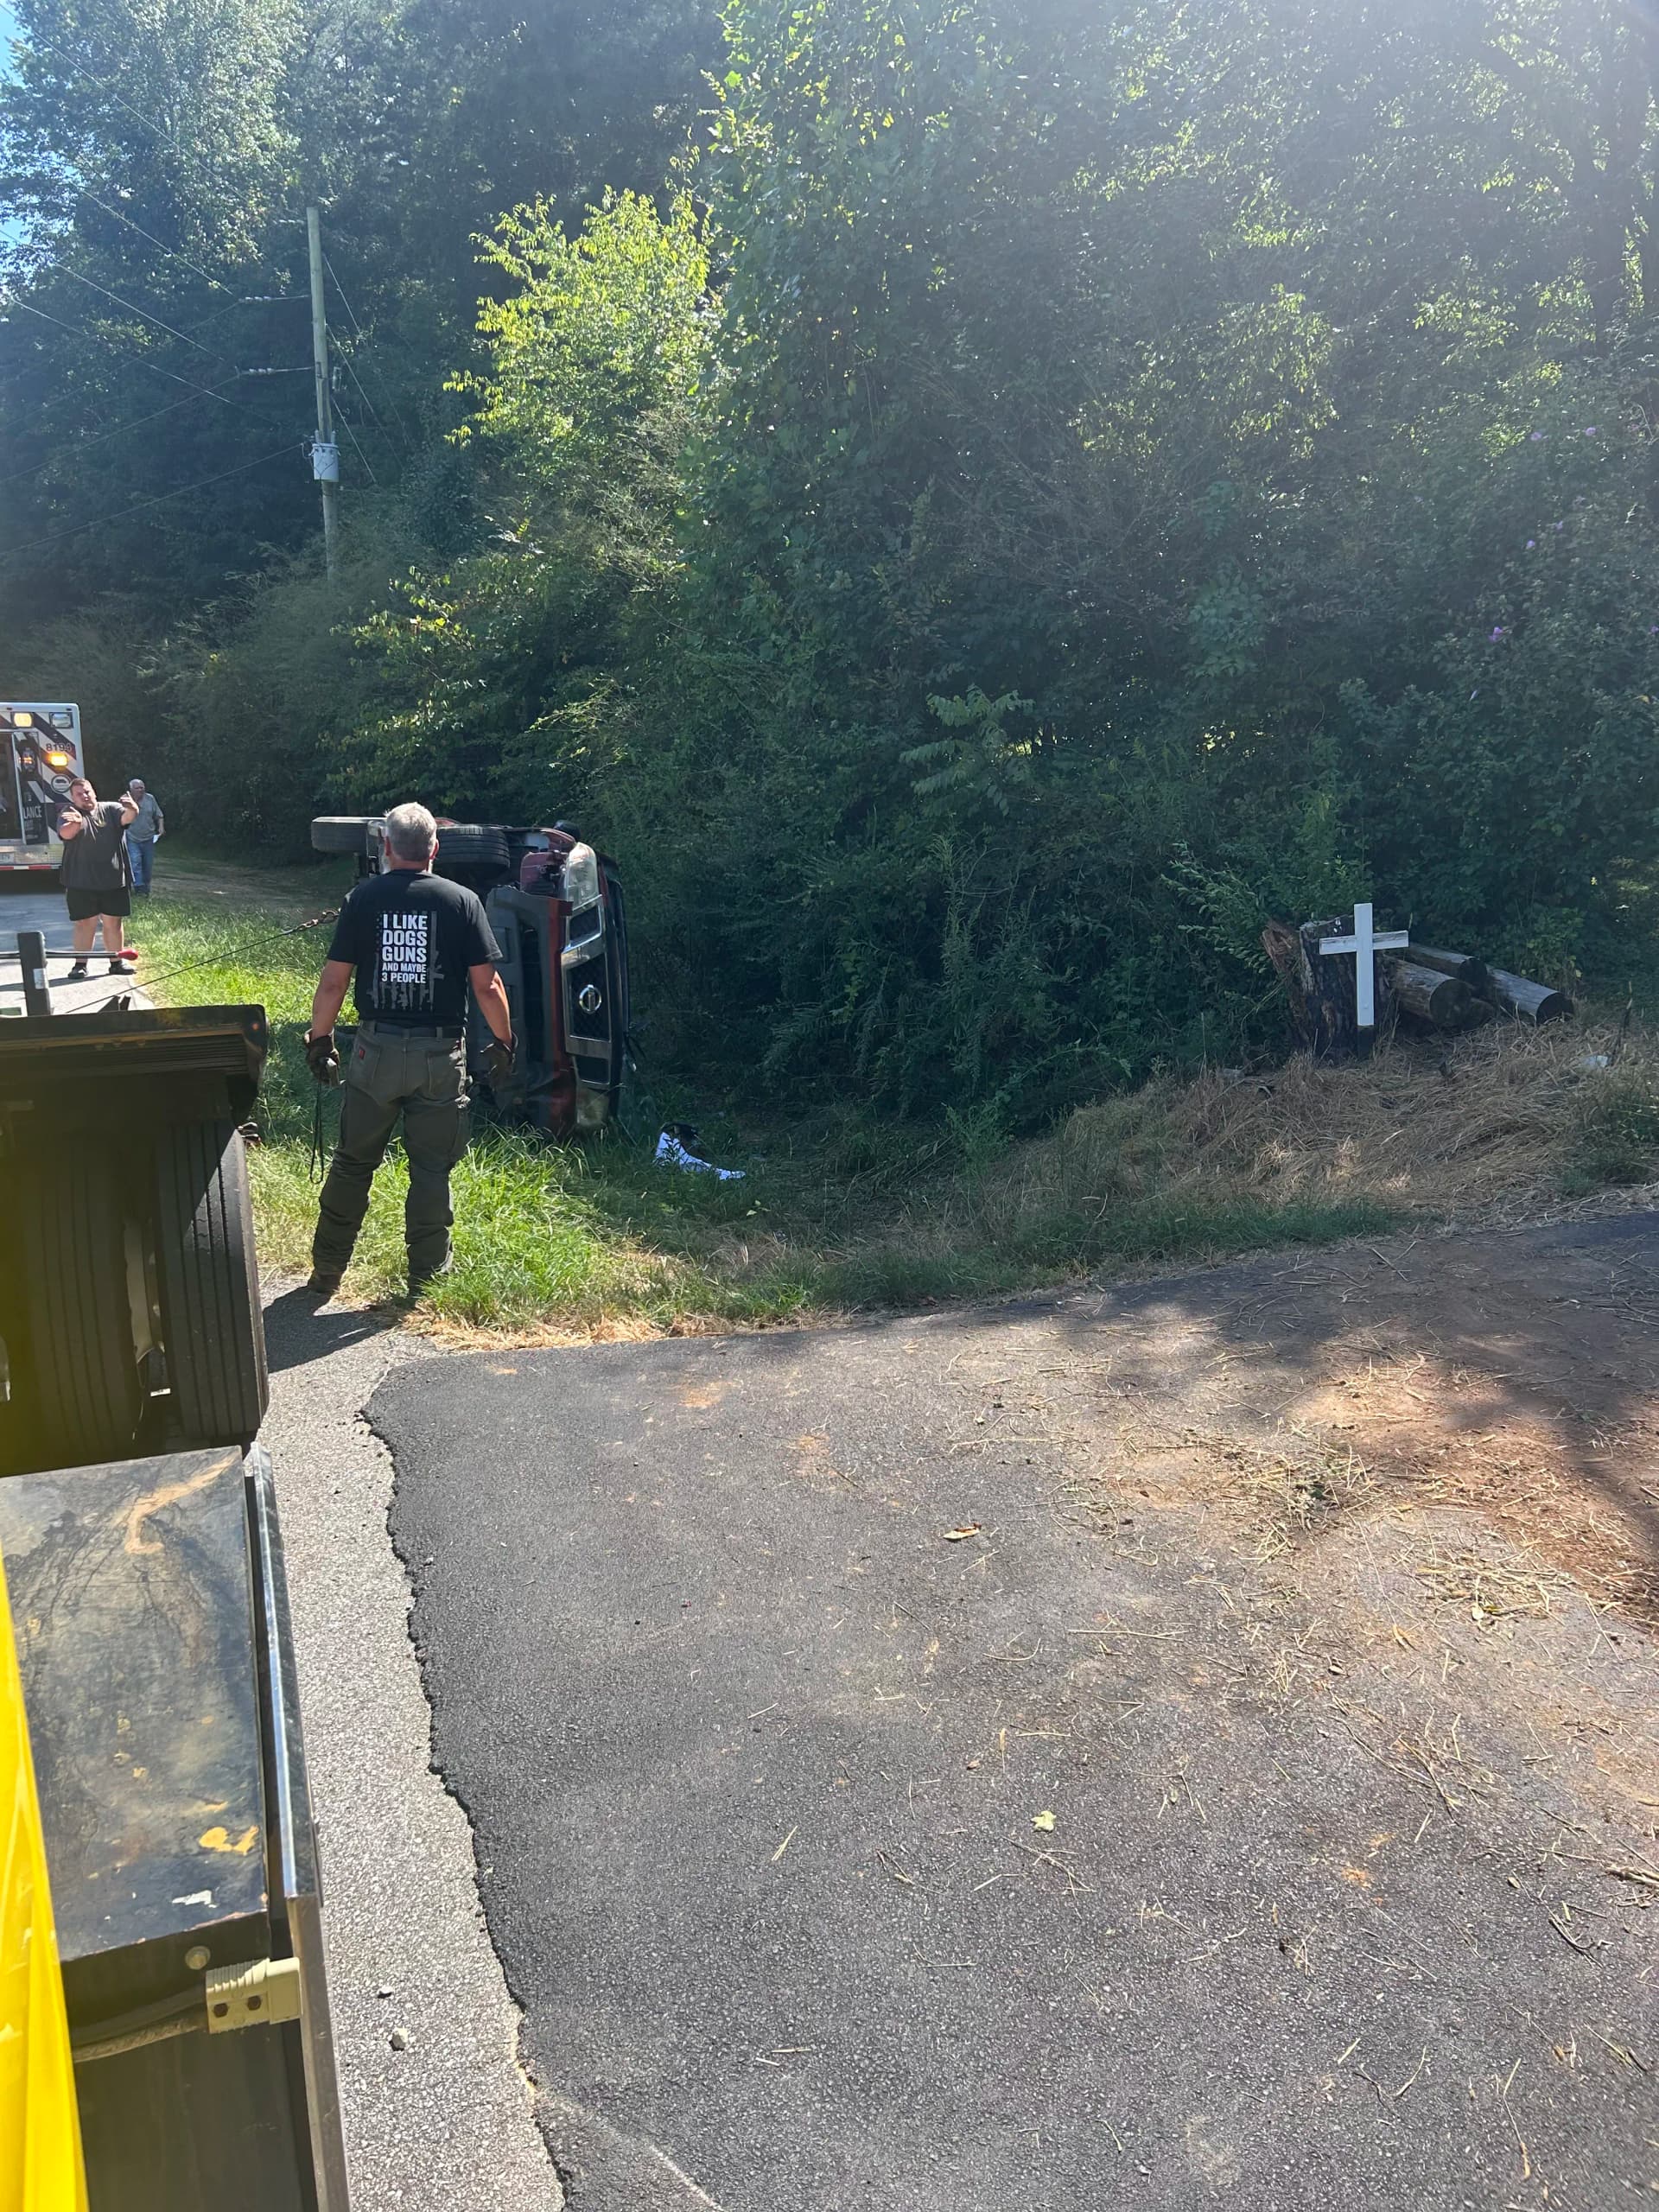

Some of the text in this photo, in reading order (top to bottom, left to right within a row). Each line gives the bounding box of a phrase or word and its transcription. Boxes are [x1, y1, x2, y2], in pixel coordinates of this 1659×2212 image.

[383, 914, 428, 930] I LIKE
[382, 930, 428, 947] DOGS
[382, 946, 427, 963] GUNS
[382, 963, 427, 973] AND MAYBE
[381, 972, 427, 983] 3 PEOPLE
